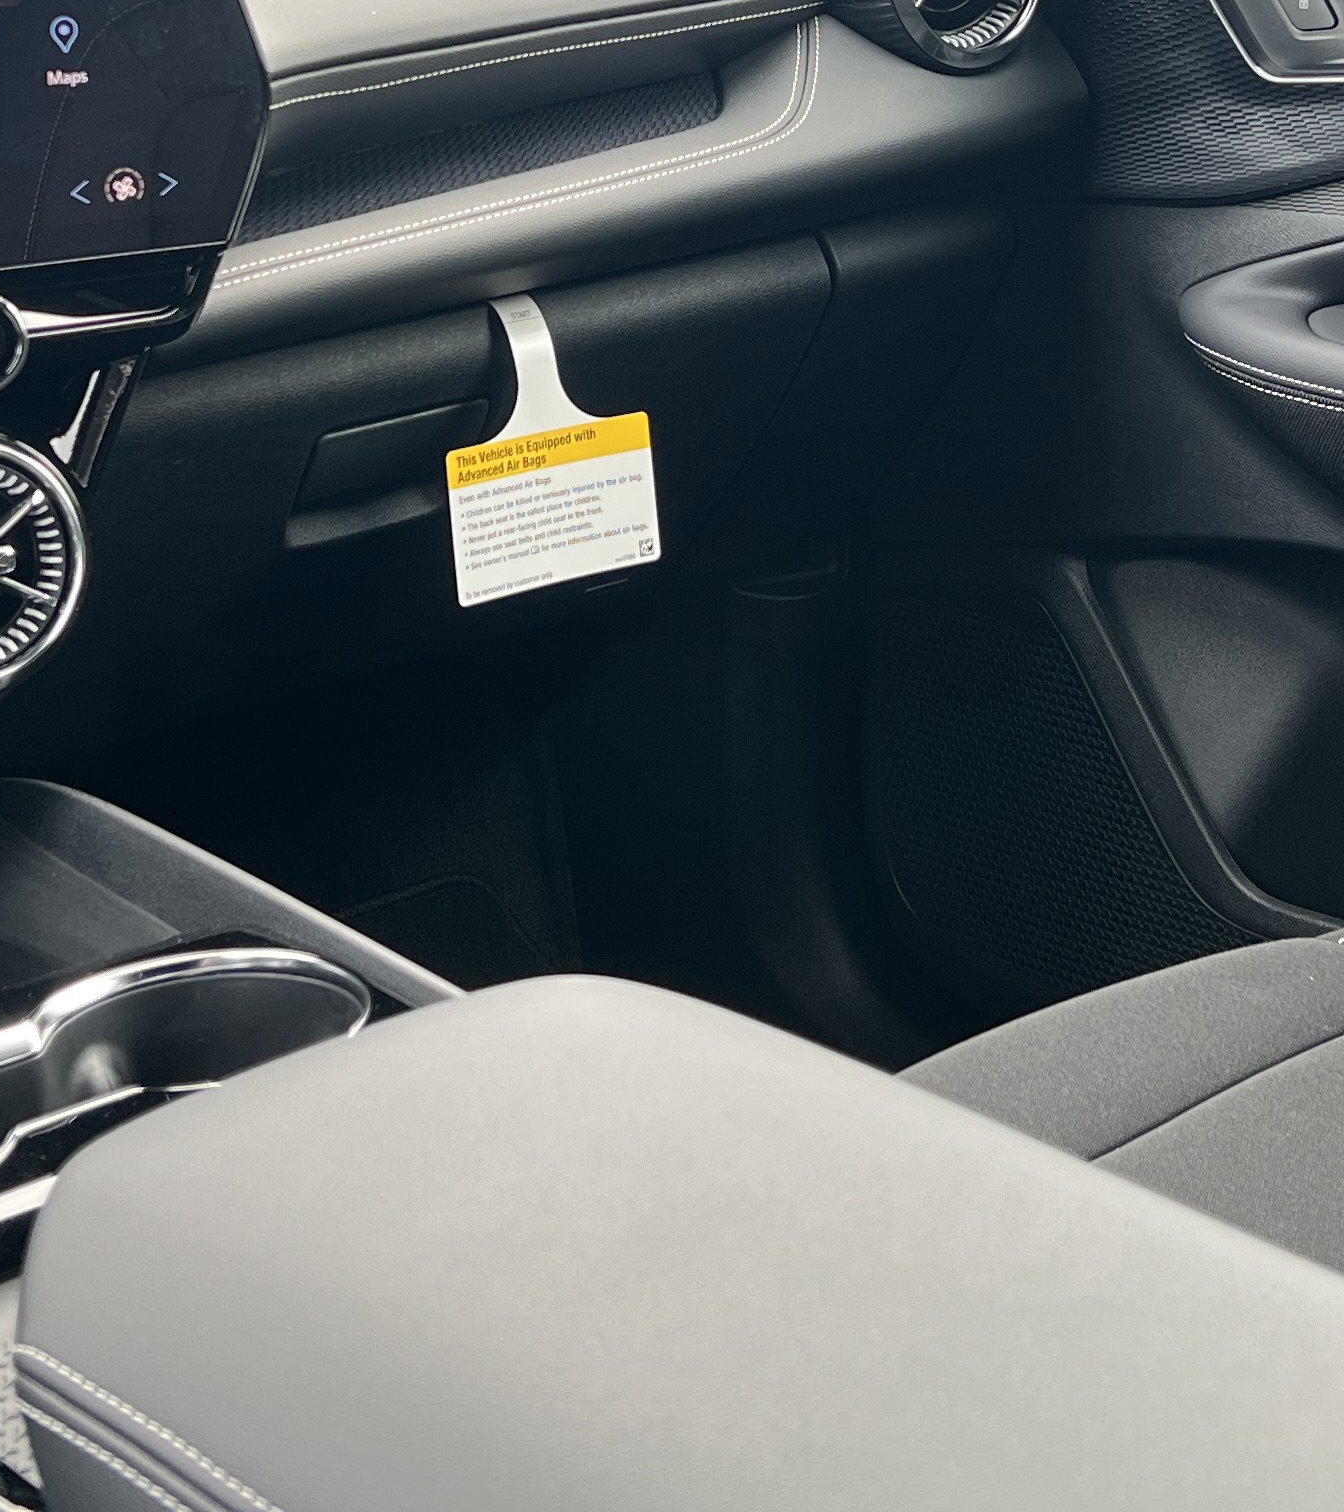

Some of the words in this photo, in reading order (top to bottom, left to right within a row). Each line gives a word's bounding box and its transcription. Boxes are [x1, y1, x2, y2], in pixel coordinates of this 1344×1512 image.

[46, 69, 89, 87] Maps
[456, 454, 477, 468] This
[479, 446, 514, 464] Vehicle
[516, 443, 525, 455] is
[526, 432, 572, 453] Equipped
[574, 428, 596, 442] with
[457, 462, 504, 484] Advanced
[507, 459, 520, 472] Air
[522, 454, 547, 469] Bags
[459, 494, 475, 504] Even
[477, 490, 491, 500] with
[492, 482, 523, 496] Advanced
[525, 479, 533, 488] Air
[466, 506, 492, 518] Children
[494, 503, 505, 511] can
[516, 496, 533, 506] killed
[572, 482, 595, 494] injured
[597, 481, 604, 489] by
[618, 476, 627, 484] air
[467, 523, 478, 531] The
[479, 519, 493, 528] back
[495, 515, 508, 524] seat
[527, 506, 545, 516] safest
[546, 502, 563, 513] place
[468, 535, 486, 544] Never
[487, 531, 497, 540] put
[504, 522, 536, 535] rear-facing
[537, 517, 552, 527] child
[554, 514, 566, 523] seat
[470, 547, 491, 557] Always
[546, 528, 562, 537] child
[471, 562, 482, 570] See
[508, 549, 529, 559] manual
[551, 540, 567, 549] more
[567, 532, 602, 546] information
[604, 528, 621, 538] about
[622, 525, 630, 534] air
[481, 583, 505, 595] removed
[514, 575, 540, 587] customer
